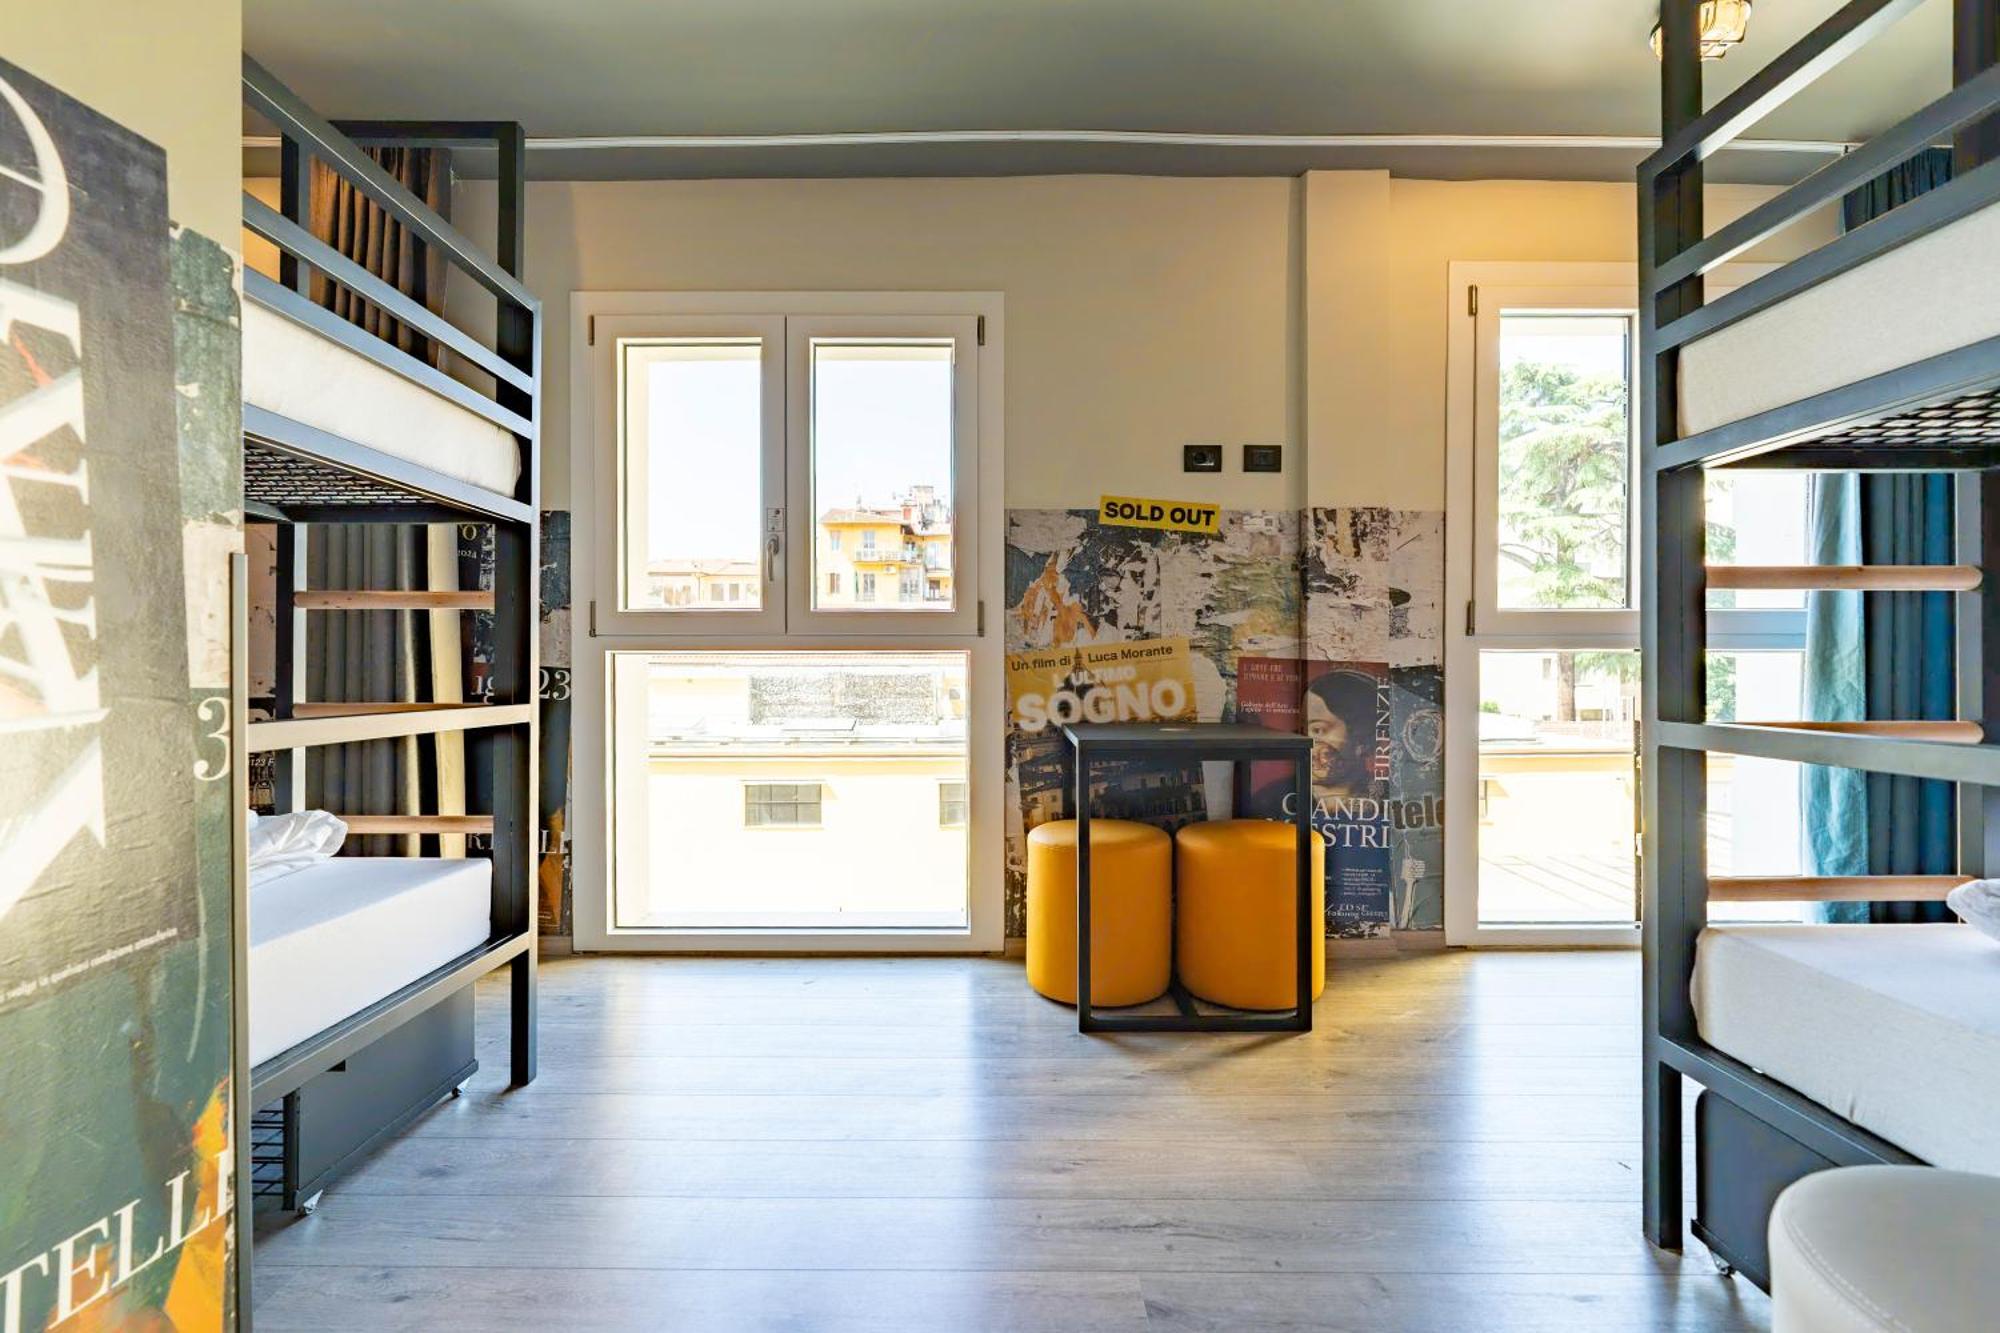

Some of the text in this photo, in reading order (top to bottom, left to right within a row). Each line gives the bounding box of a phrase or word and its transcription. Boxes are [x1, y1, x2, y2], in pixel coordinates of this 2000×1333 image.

[1104, 502, 1216, 527] SOLD OUT
[1011, 645, 1174, 672] Un film di Luca Morante
[1017, 678, 1186, 732] SOGNO
[1374, 676, 1391, 782] FIRENZE
